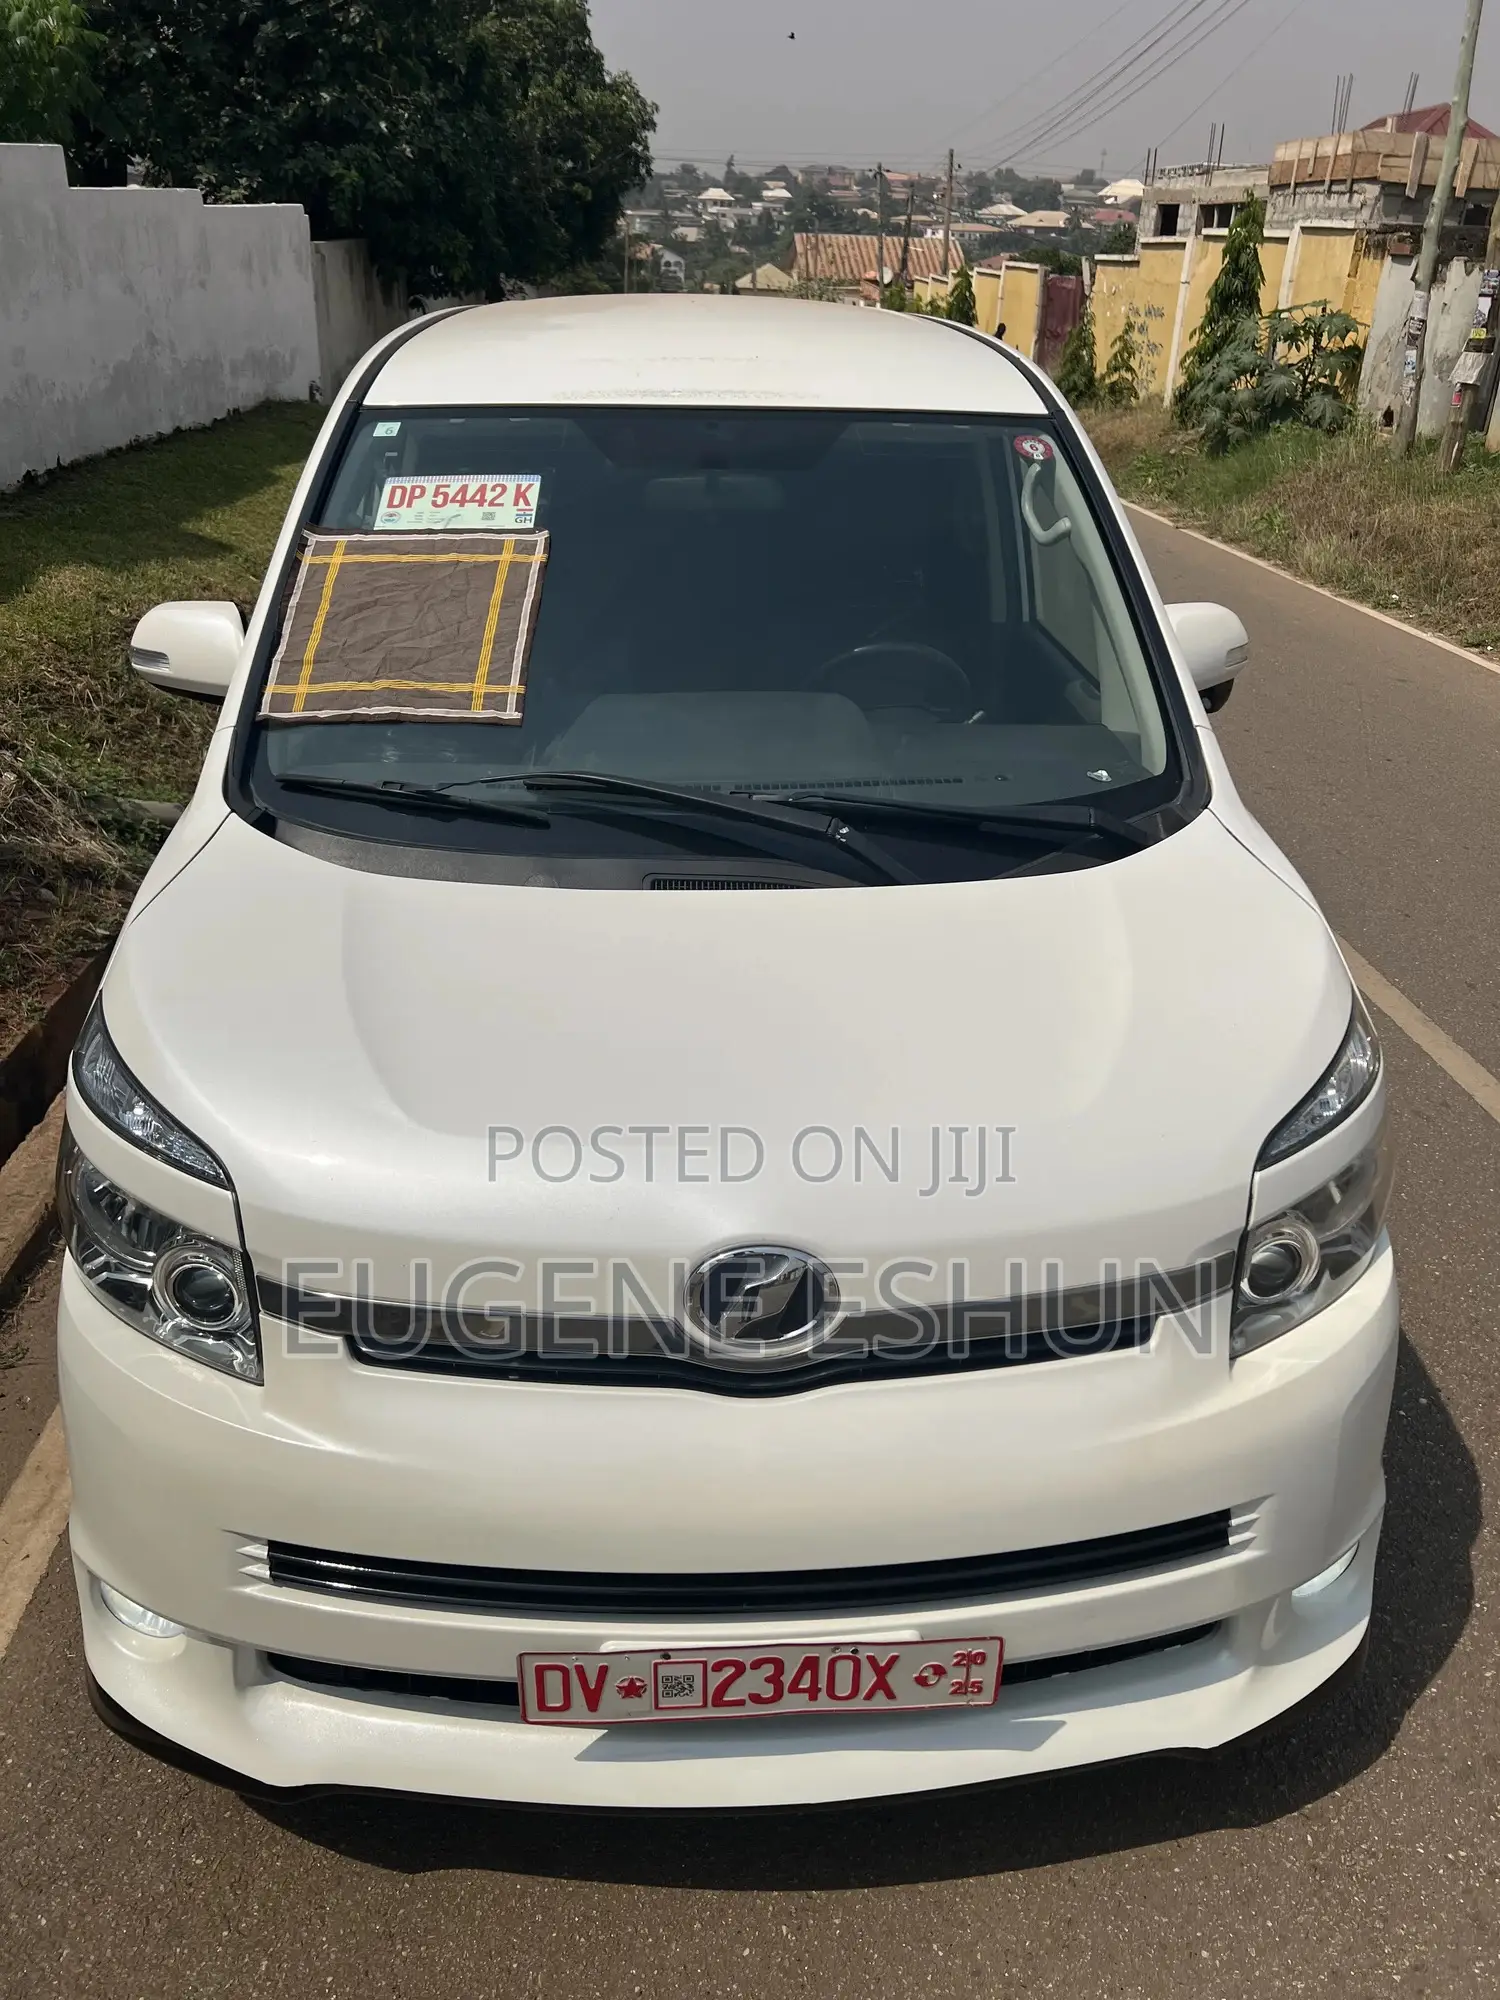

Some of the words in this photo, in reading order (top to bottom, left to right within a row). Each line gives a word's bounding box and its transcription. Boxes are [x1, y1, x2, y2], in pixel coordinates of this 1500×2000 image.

[386, 484, 427, 508] DP
[431, 483, 508, 508] 5442
[513, 483, 535, 507] K
[514, 516, 533, 524] GH
[951, 1649, 988, 1667] 20
[534, 1662, 609, 1713] DV
[948, 1678, 984, 1695] 25
